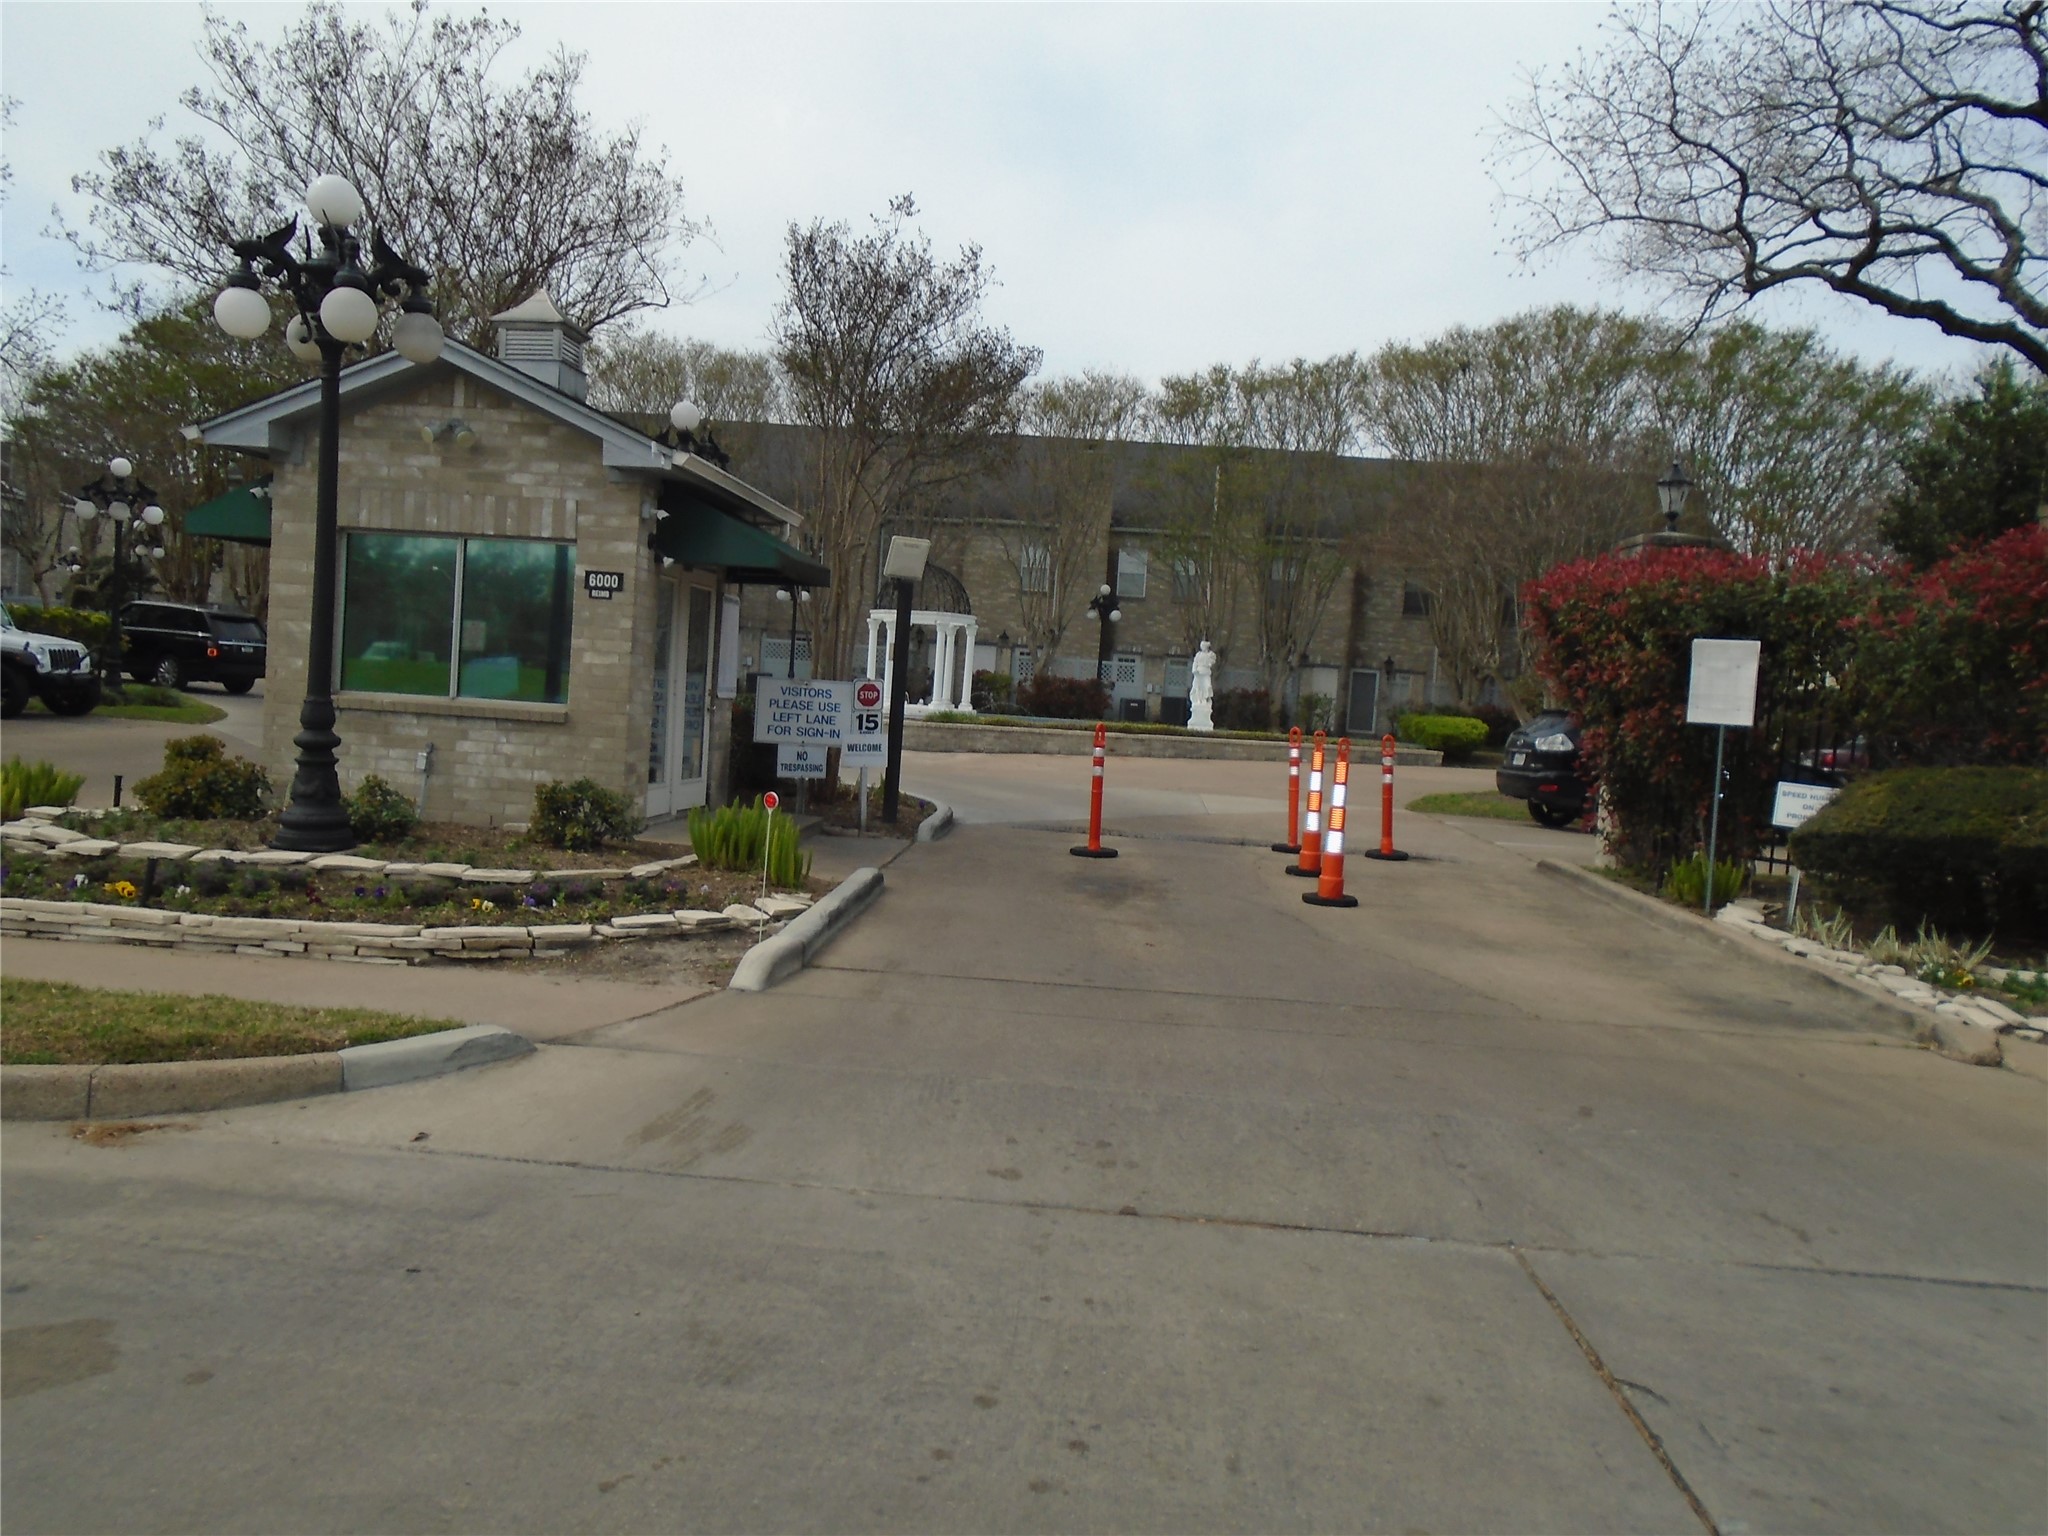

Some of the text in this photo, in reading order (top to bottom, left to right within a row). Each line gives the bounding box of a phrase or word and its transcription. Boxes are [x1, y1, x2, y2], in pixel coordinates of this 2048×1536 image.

[589, 573, 619, 588] 6000
[780, 686, 832, 699] VISITORS
[769, 699, 841, 713] PLEASE USE
[773, 712, 837, 725] LEFT LANE
[856, 713, 879, 731] 15
[767, 725, 841, 739] FOR SIGN-IN
[847, 743, 882, 752] WELCOME
[796, 751, 808, 761] NO
[780, 762, 824, 772] TRESPASSING
[1782, 790, 1808, 799] SPEED
[1802, 803, 1814, 811] ON
